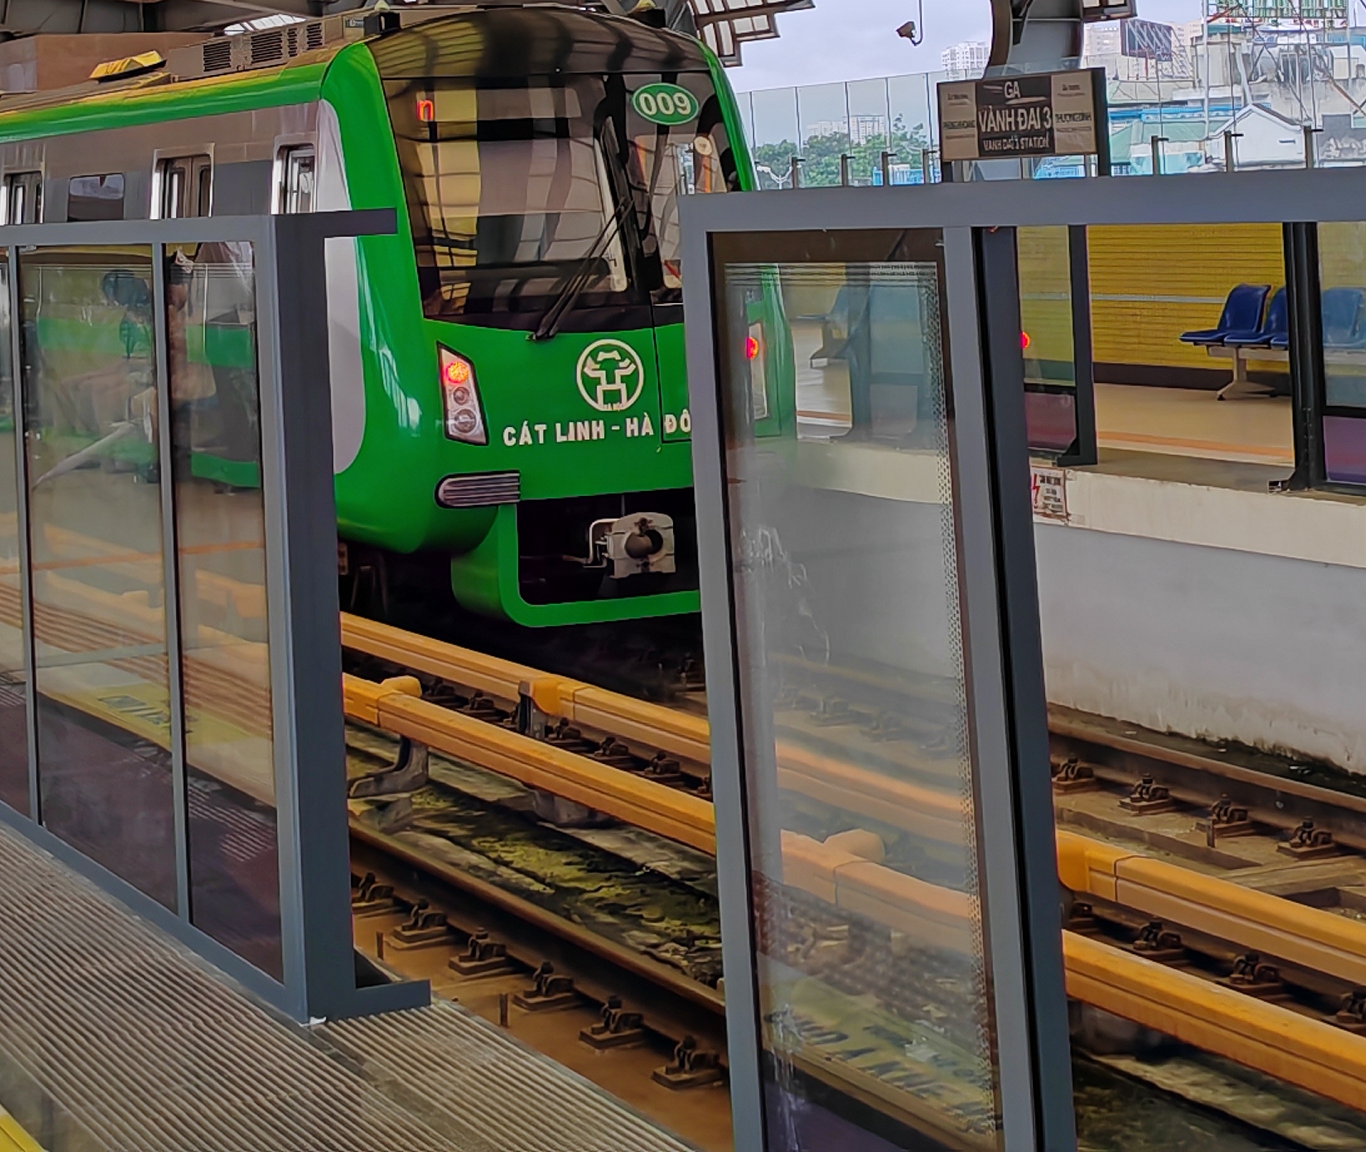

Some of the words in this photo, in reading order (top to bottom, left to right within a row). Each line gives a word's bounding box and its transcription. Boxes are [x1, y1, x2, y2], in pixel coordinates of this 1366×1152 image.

[1004, 81, 1021, 98] GA
[638, 91, 691, 115] 009
[978, 105, 1015, 132] VÀNH
[1017, 106, 1041, 130] ĐAI
[1043, 106, 1052, 129] 3
[502, 420, 547, 446] CÁT
[555, 420, 605, 443] LINH
[625, 412, 654, 437] HÀ
